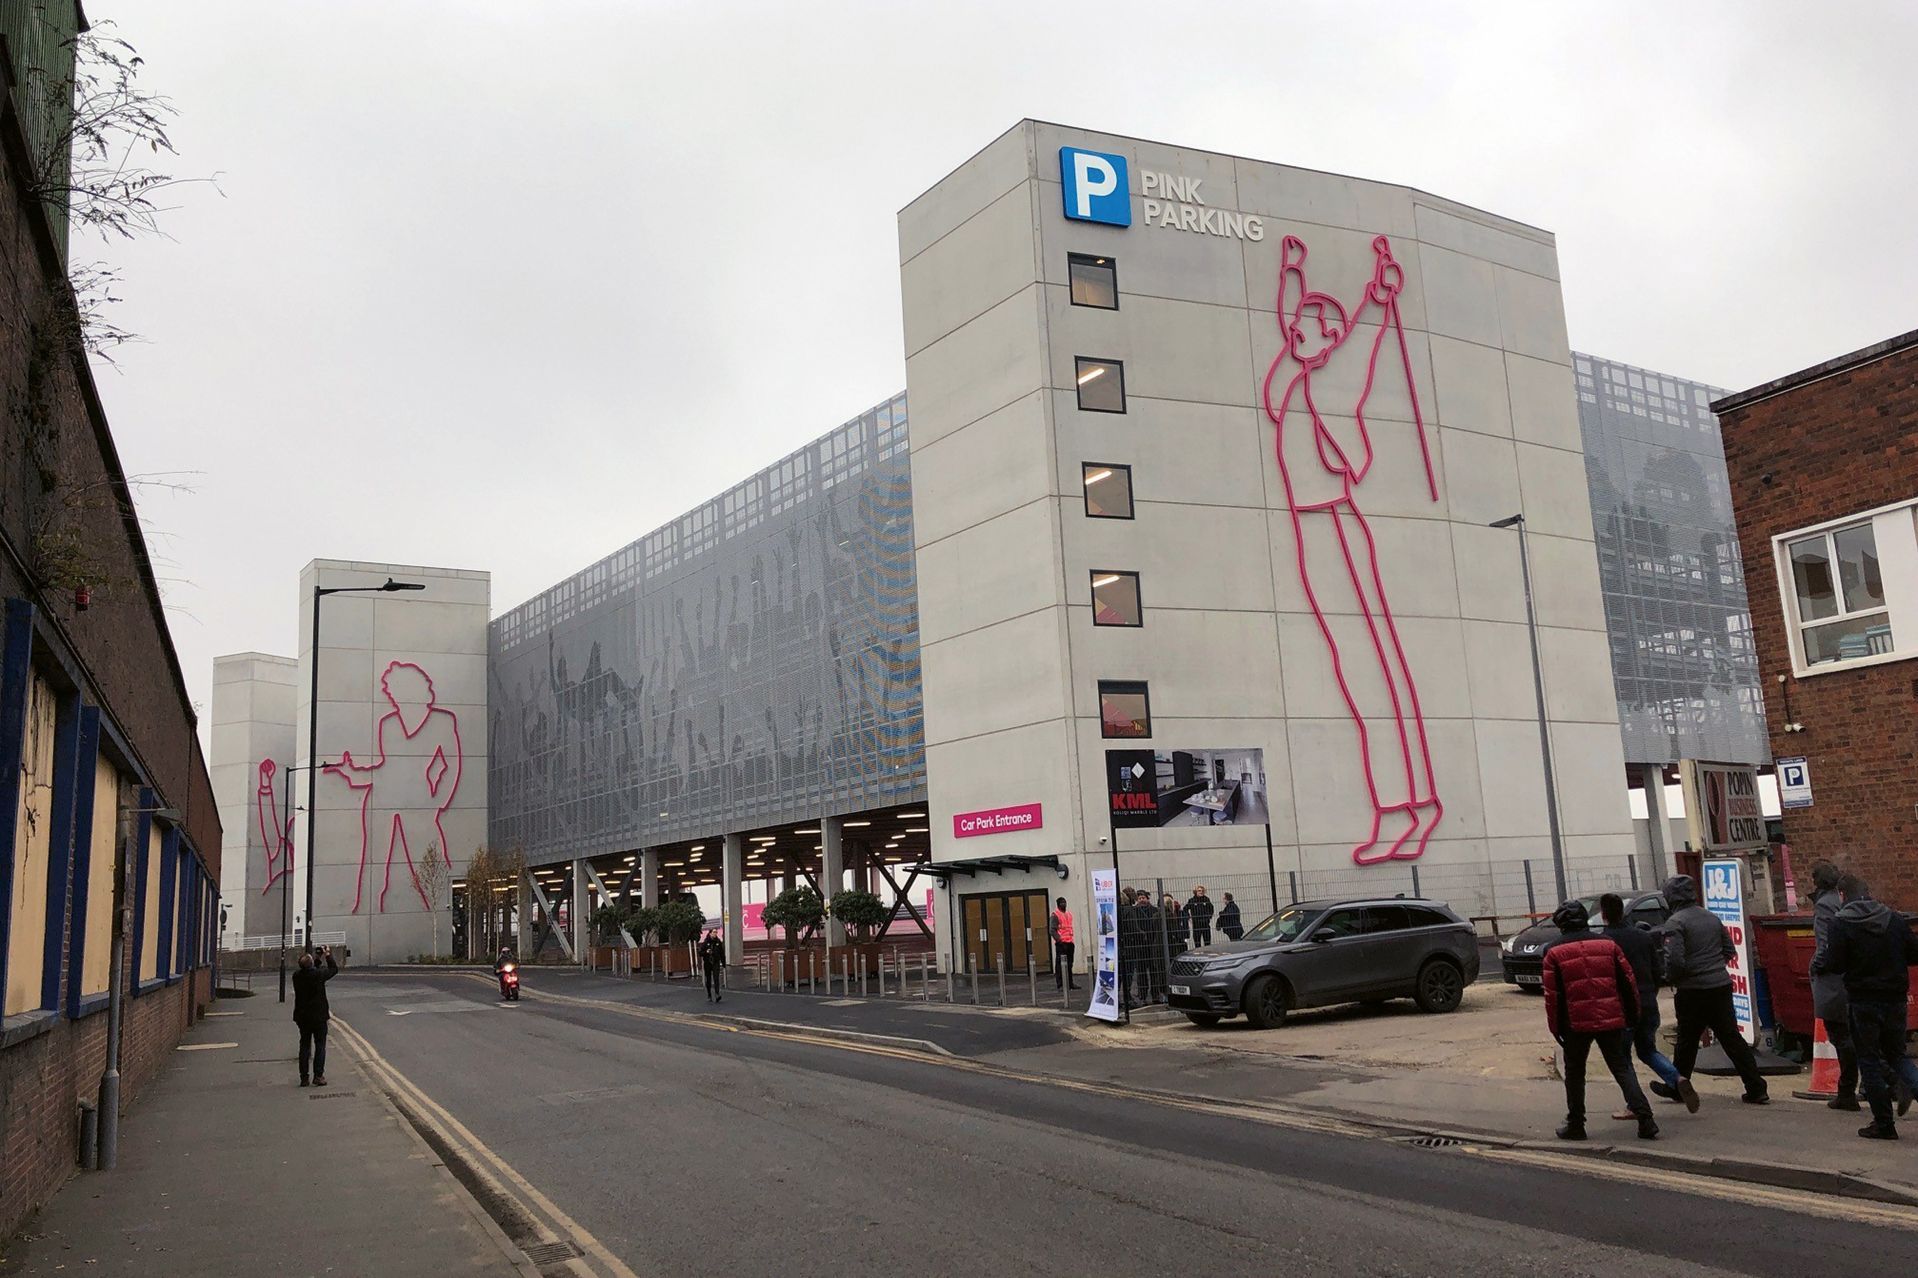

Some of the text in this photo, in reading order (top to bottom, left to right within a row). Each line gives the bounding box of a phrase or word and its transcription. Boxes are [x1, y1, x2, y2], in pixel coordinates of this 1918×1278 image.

[1073, 152, 1118, 217] P
[1140, 169, 1205, 206] PINK
[1143, 198, 1264, 242] PARKING
[1112, 793, 1157, 809] KML
[961, 813, 1032, 831] Car Park Entrance
[1729, 818, 1761, 842] CENTRE
[1707, 868, 1737, 899] J&J
